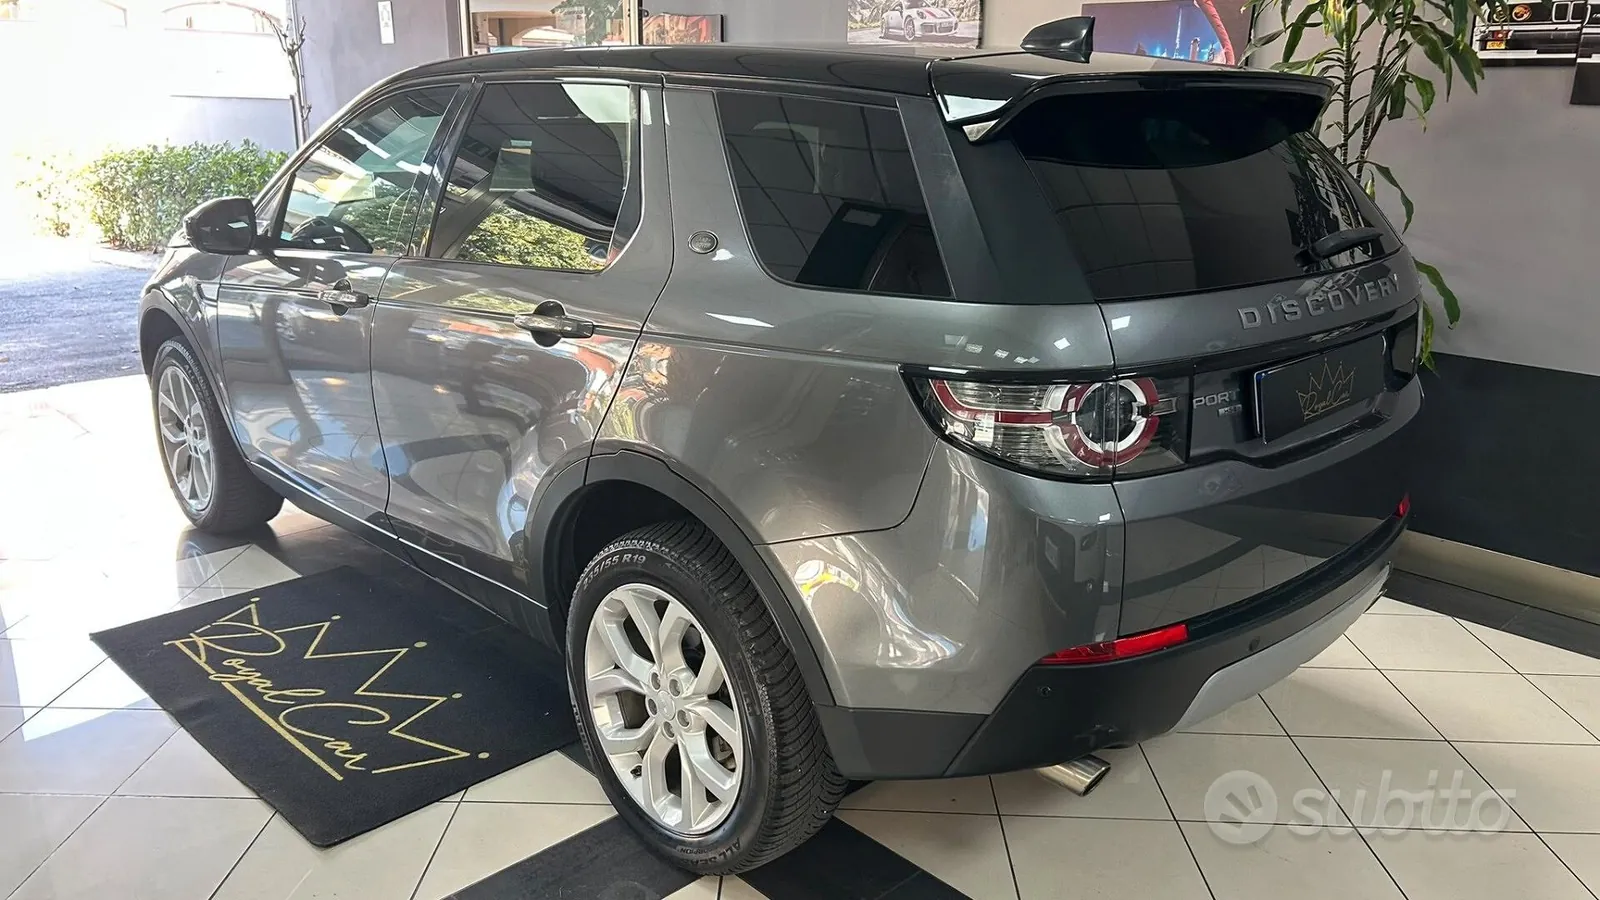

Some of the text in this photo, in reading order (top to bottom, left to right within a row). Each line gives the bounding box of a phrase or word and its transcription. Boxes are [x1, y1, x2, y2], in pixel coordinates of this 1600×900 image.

[1237, 273, 1400, 329] DISCOVERY
[1193, 388, 1240, 409] PORT
[621, 553, 646, 565] R19
[187, 621, 391, 771] Royal Car
